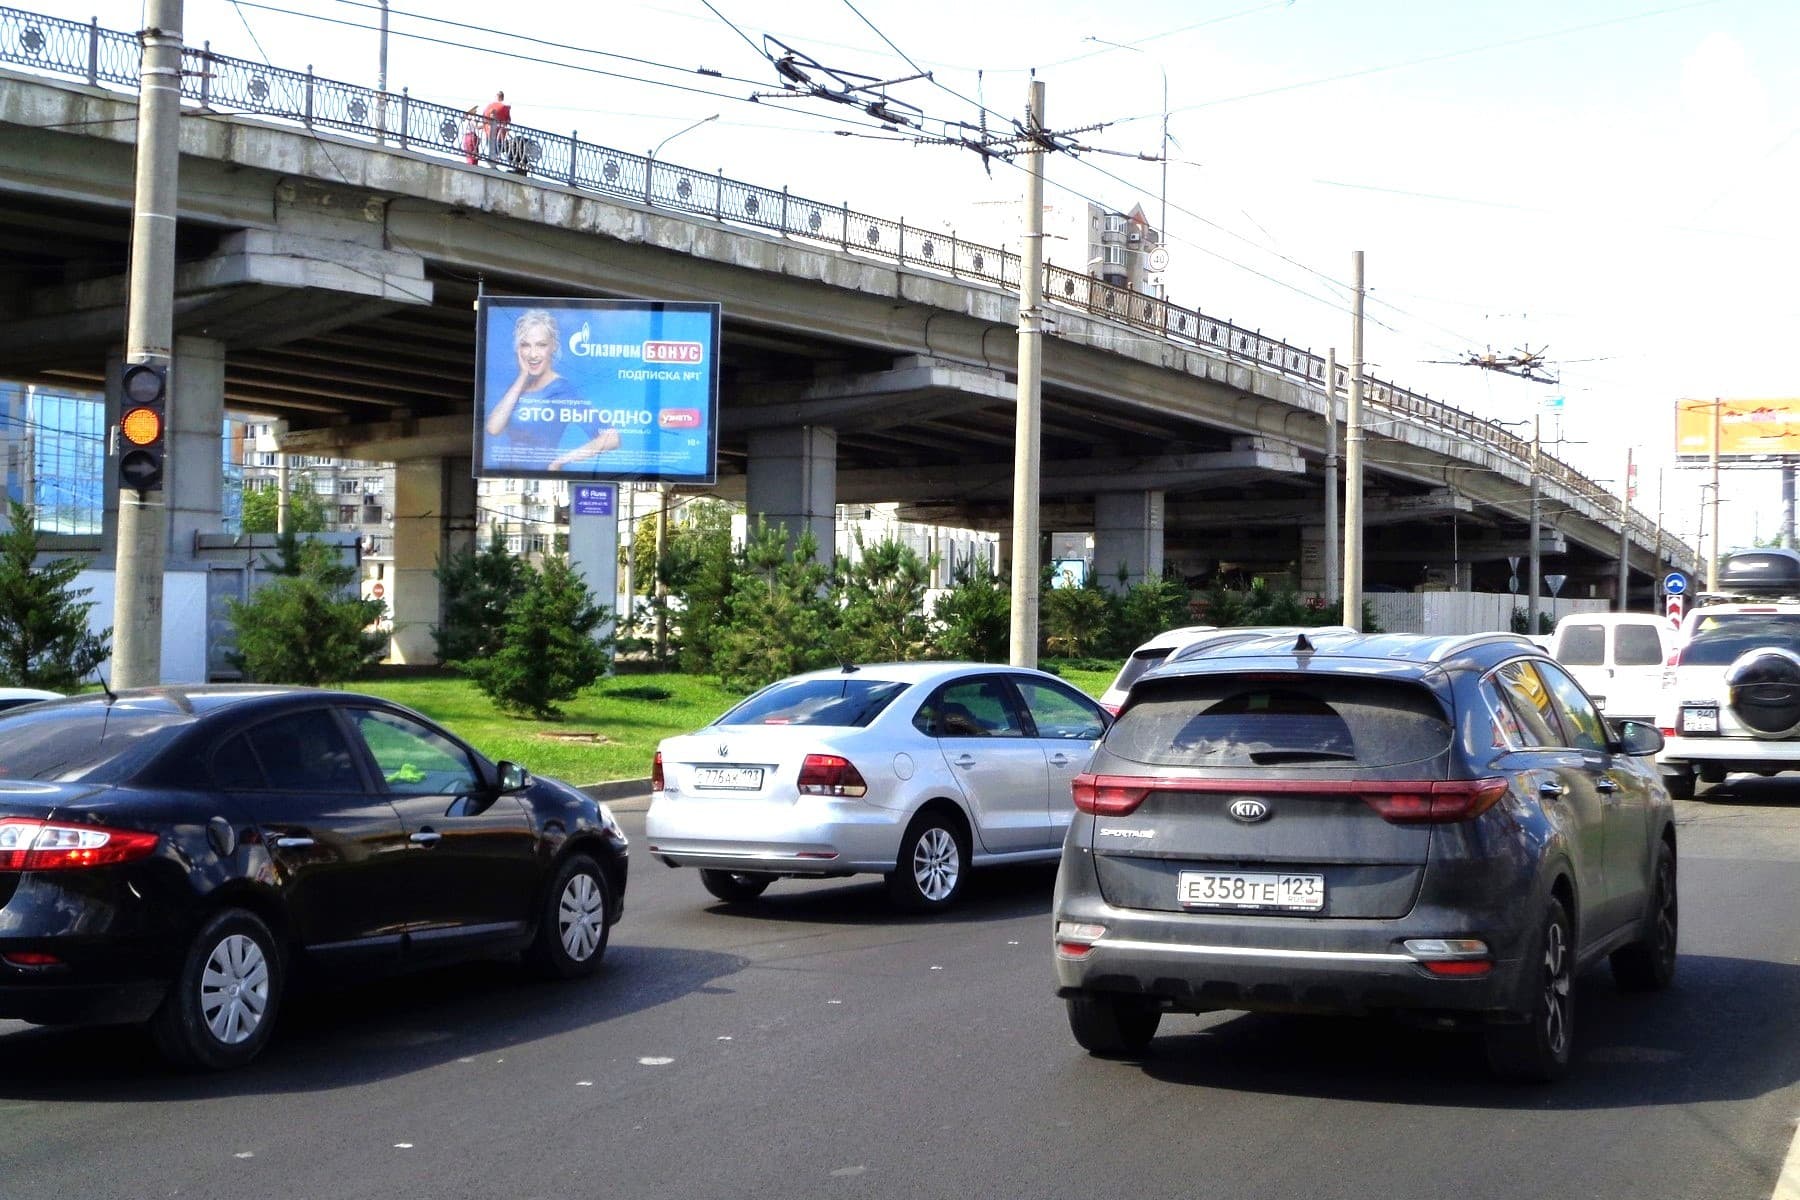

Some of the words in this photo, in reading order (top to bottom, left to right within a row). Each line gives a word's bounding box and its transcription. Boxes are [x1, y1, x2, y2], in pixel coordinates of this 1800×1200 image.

[590, 343, 642, 358] ГАЗПРОМ
[646, 344, 699, 360] БОНУС
[617, 369, 681, 381] ПОДПИСКА
[518, 407, 555, 422] ЭТО
[559, 408, 653, 427] ВЫГОДНО
[1236, 802, 1260, 816] KIA
[1188, 876, 1275, 901] Е358ТЕ
[1282, 877, 1315, 895] 123
